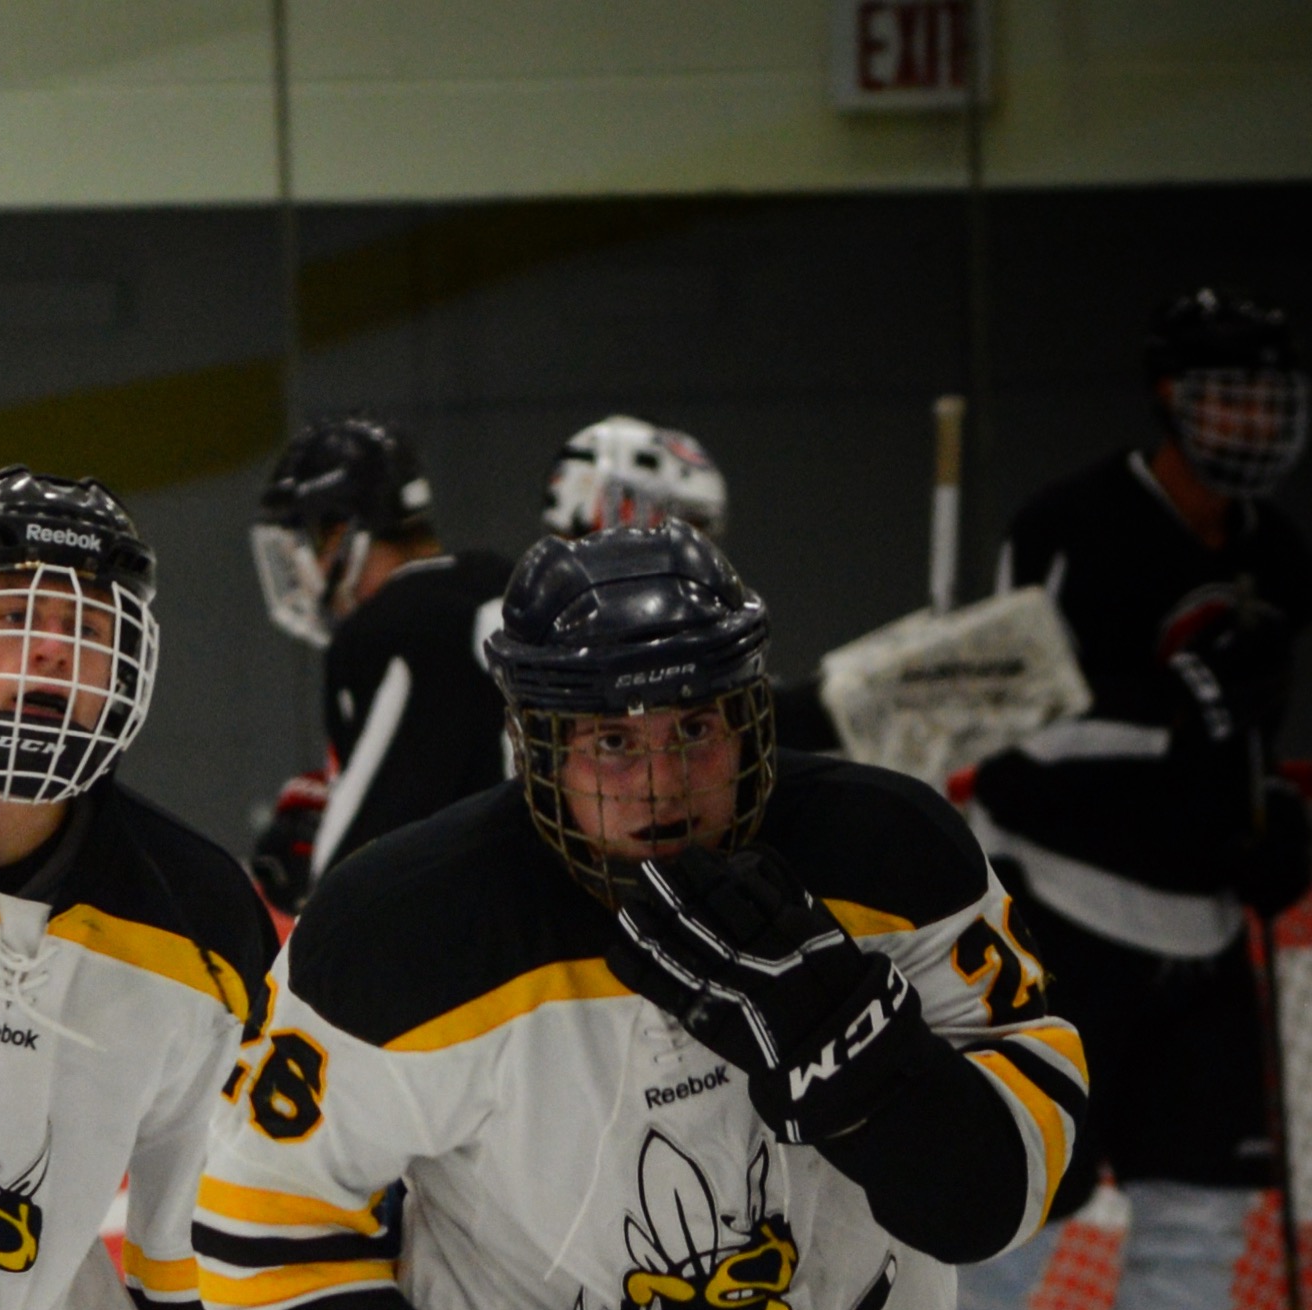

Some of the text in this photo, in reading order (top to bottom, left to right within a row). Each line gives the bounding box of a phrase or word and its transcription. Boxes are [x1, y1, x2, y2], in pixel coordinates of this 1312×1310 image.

[857, 1, 973, 90] EXIT
[25, 522, 103, 552] Reebok
[788, 960, 911, 1102] CCM
[644, 1066, 731, 1109] Reebok
